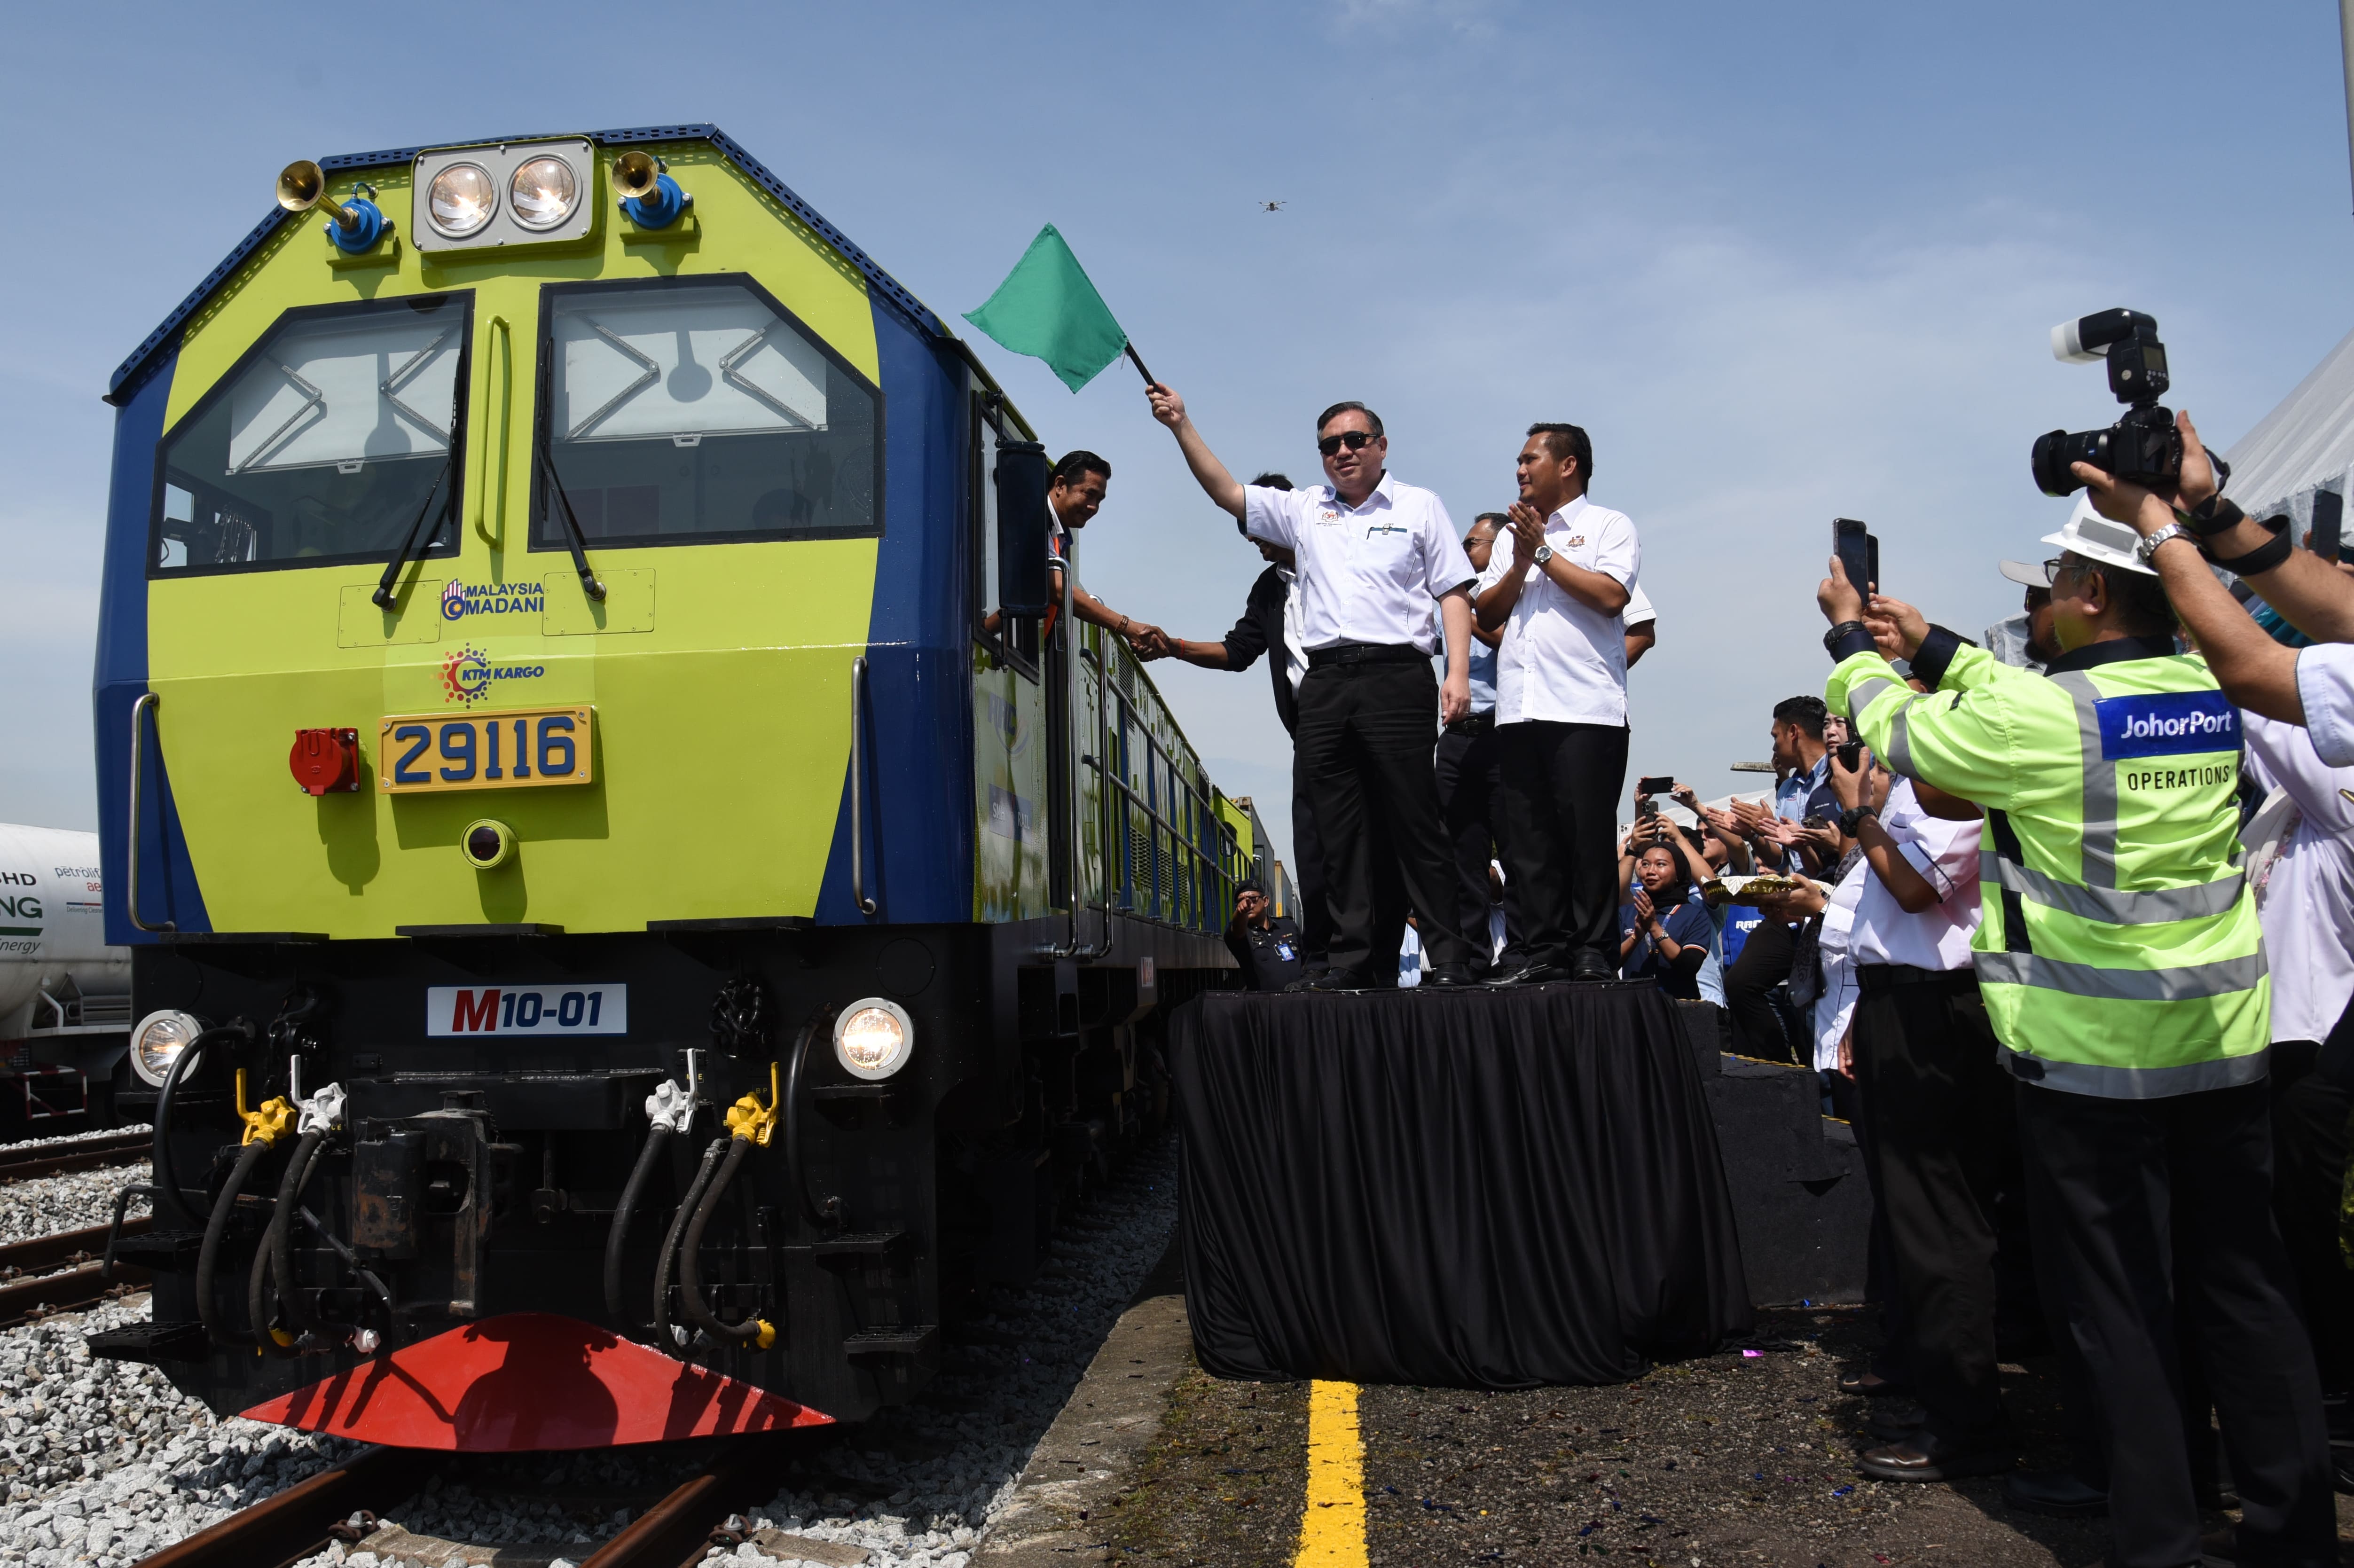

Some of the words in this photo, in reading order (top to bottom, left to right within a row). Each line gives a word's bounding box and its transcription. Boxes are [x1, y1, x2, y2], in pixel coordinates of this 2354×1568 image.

[466, 583, 543, 597] MALAYSIA
[465, 597, 543, 615] MADANI
[462, 669, 491, 681] KTM
[494, 666, 544, 680] KARGO
[2121, 711, 2232, 739] JohorPort
[395, 716, 575, 783] 29116
[2127, 765, 2230, 791] OPERATIONS
[993, 802, 1005, 821] SMH
[1018, 811, 1030, 830] RAIL
[0, 872, 37, 886] HD
[0, 938, 41, 954] nergy
[452, 989, 602, 1032] M10-01
